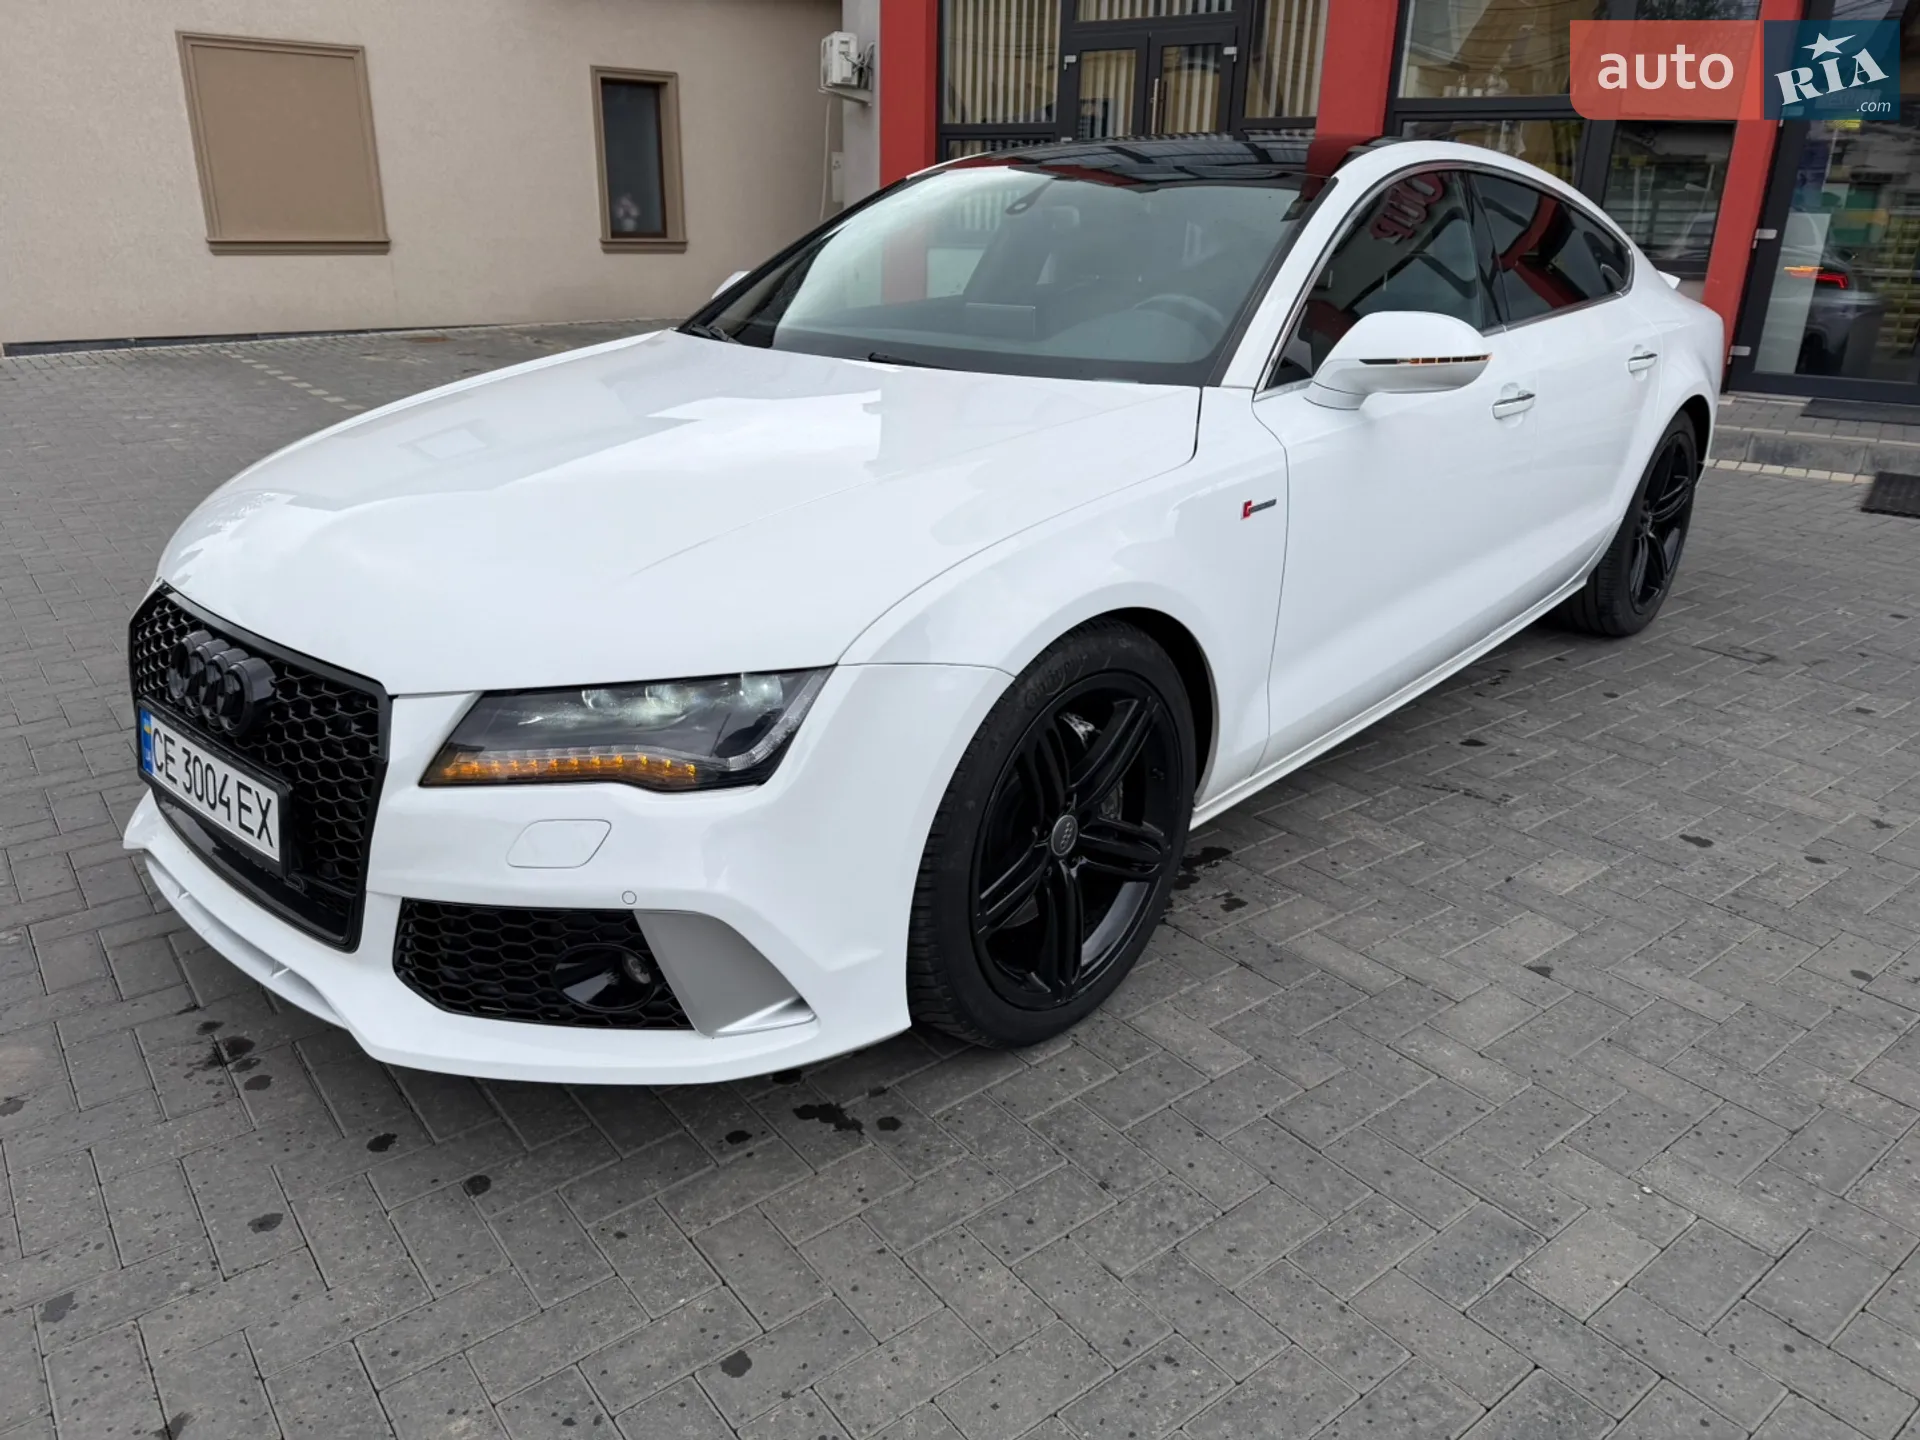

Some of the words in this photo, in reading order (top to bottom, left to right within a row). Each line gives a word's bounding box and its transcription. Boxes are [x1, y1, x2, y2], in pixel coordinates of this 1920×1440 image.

[152, 727, 178, 785] CE
[181, 746, 232, 823] 3004
[236, 780, 274, 849] EX
